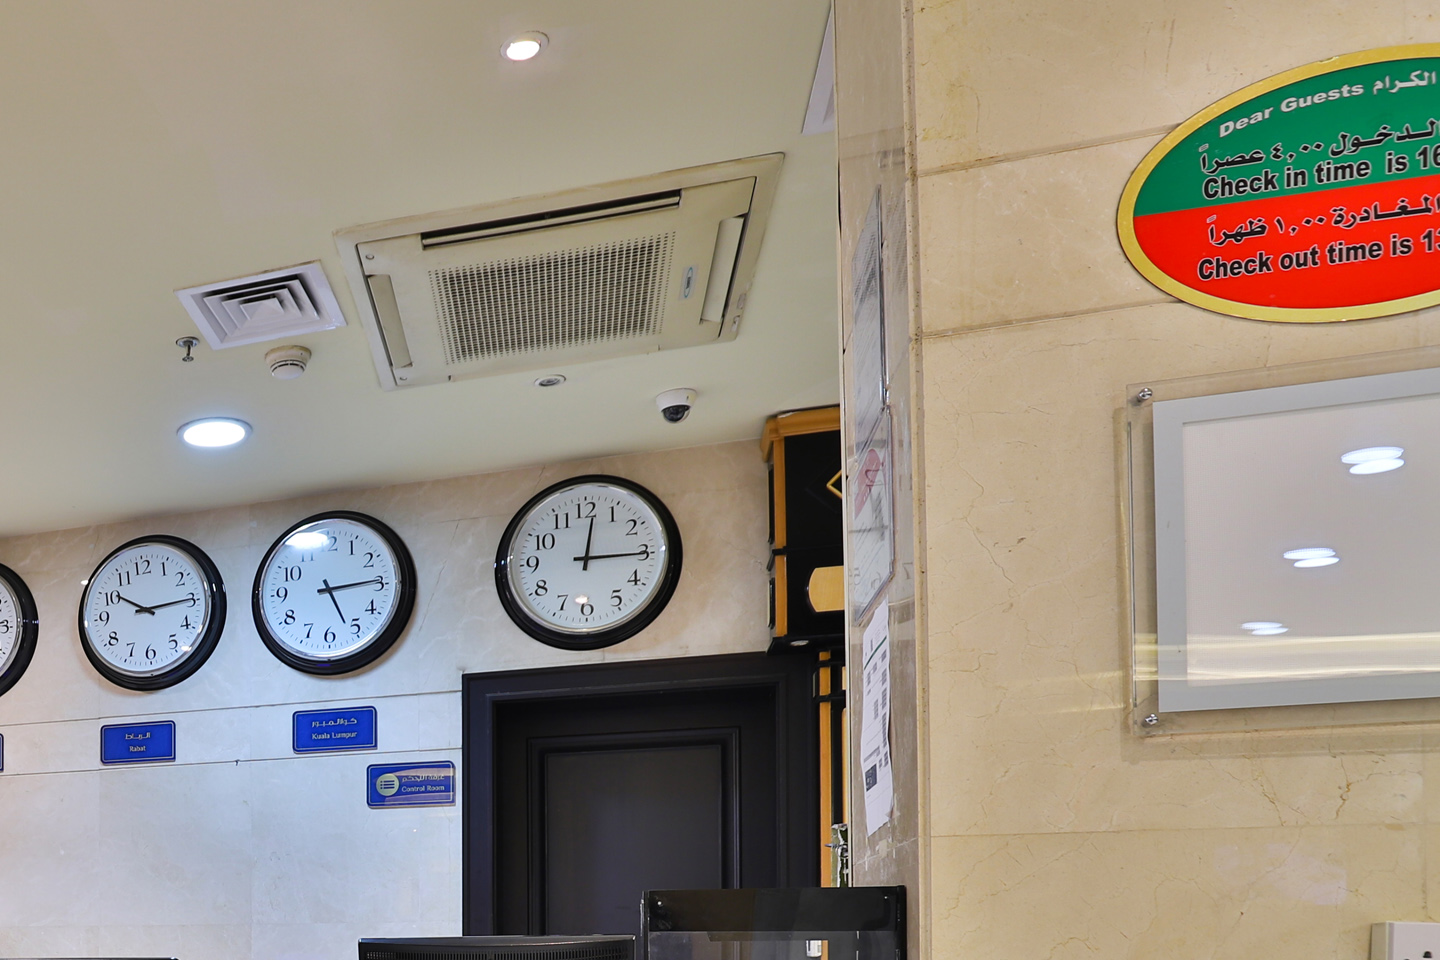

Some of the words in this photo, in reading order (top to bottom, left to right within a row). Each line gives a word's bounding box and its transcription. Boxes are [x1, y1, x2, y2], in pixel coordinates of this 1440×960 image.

[1373, 70, 1437, 95] الكرام
[1220, 107, 1274, 138] Dear
[1280, 84, 1364, 112] Guests
[1329, 117, 1440, 157] لدخول
[1202, 168, 1279, 200] Check
[1284, 165, 1308, 189] in
[1314, 160, 1372, 184] time
[1385, 151, 1409, 174] is
[1197, 250, 1274, 281] Check
[1279, 244, 1320, 271] out
[1326, 240, 1383, 265] time
[1390, 233, 1413, 257] is
[1421, 228, 1440, 253] 1
[575, 502, 597, 519] 12
[609, 505, 616, 523] 1
[553, 512, 571, 530] 11
[625, 519, 638, 536] 2
[349, 539, 355, 555] 1
[535, 533, 555, 551] 10
[363, 552, 374, 568] 2
[637, 543, 650, 561] 3
[134, 559, 151, 576] 12
[160, 561, 168, 576] 1
[526, 555, 539, 574] 9
[117, 571, 132, 587] 11
[175, 571, 185, 587] 2
[284, 565, 302, 582] 10
[627, 569, 641, 586] 4
[374, 575, 384, 591] 3
[535, 579, 548, 596] 8
[104, 590, 121, 606] 10
[186, 592, 196, 607] 3
[276, 586, 288, 604] 9
[557, 594, 568, 611] 7
[611, 589, 623, 607] 5
[364, 598, 377, 615] 4
[580, 598, 594, 616] 6
[99, 610, 110, 627] 9
[180, 614, 191, 630] 4
[284, 609, 296, 625] 8
[0, 619, 10, 634] 3
[304, 623, 314, 639] 7
[324, 626, 336, 643] 6
[350, 618, 361, 634] 5
[108, 631, 119, 646] 8
[168, 634, 178, 650] 5
[127, 642, 136, 657] 7
[145, 643, 157, 660] 6
